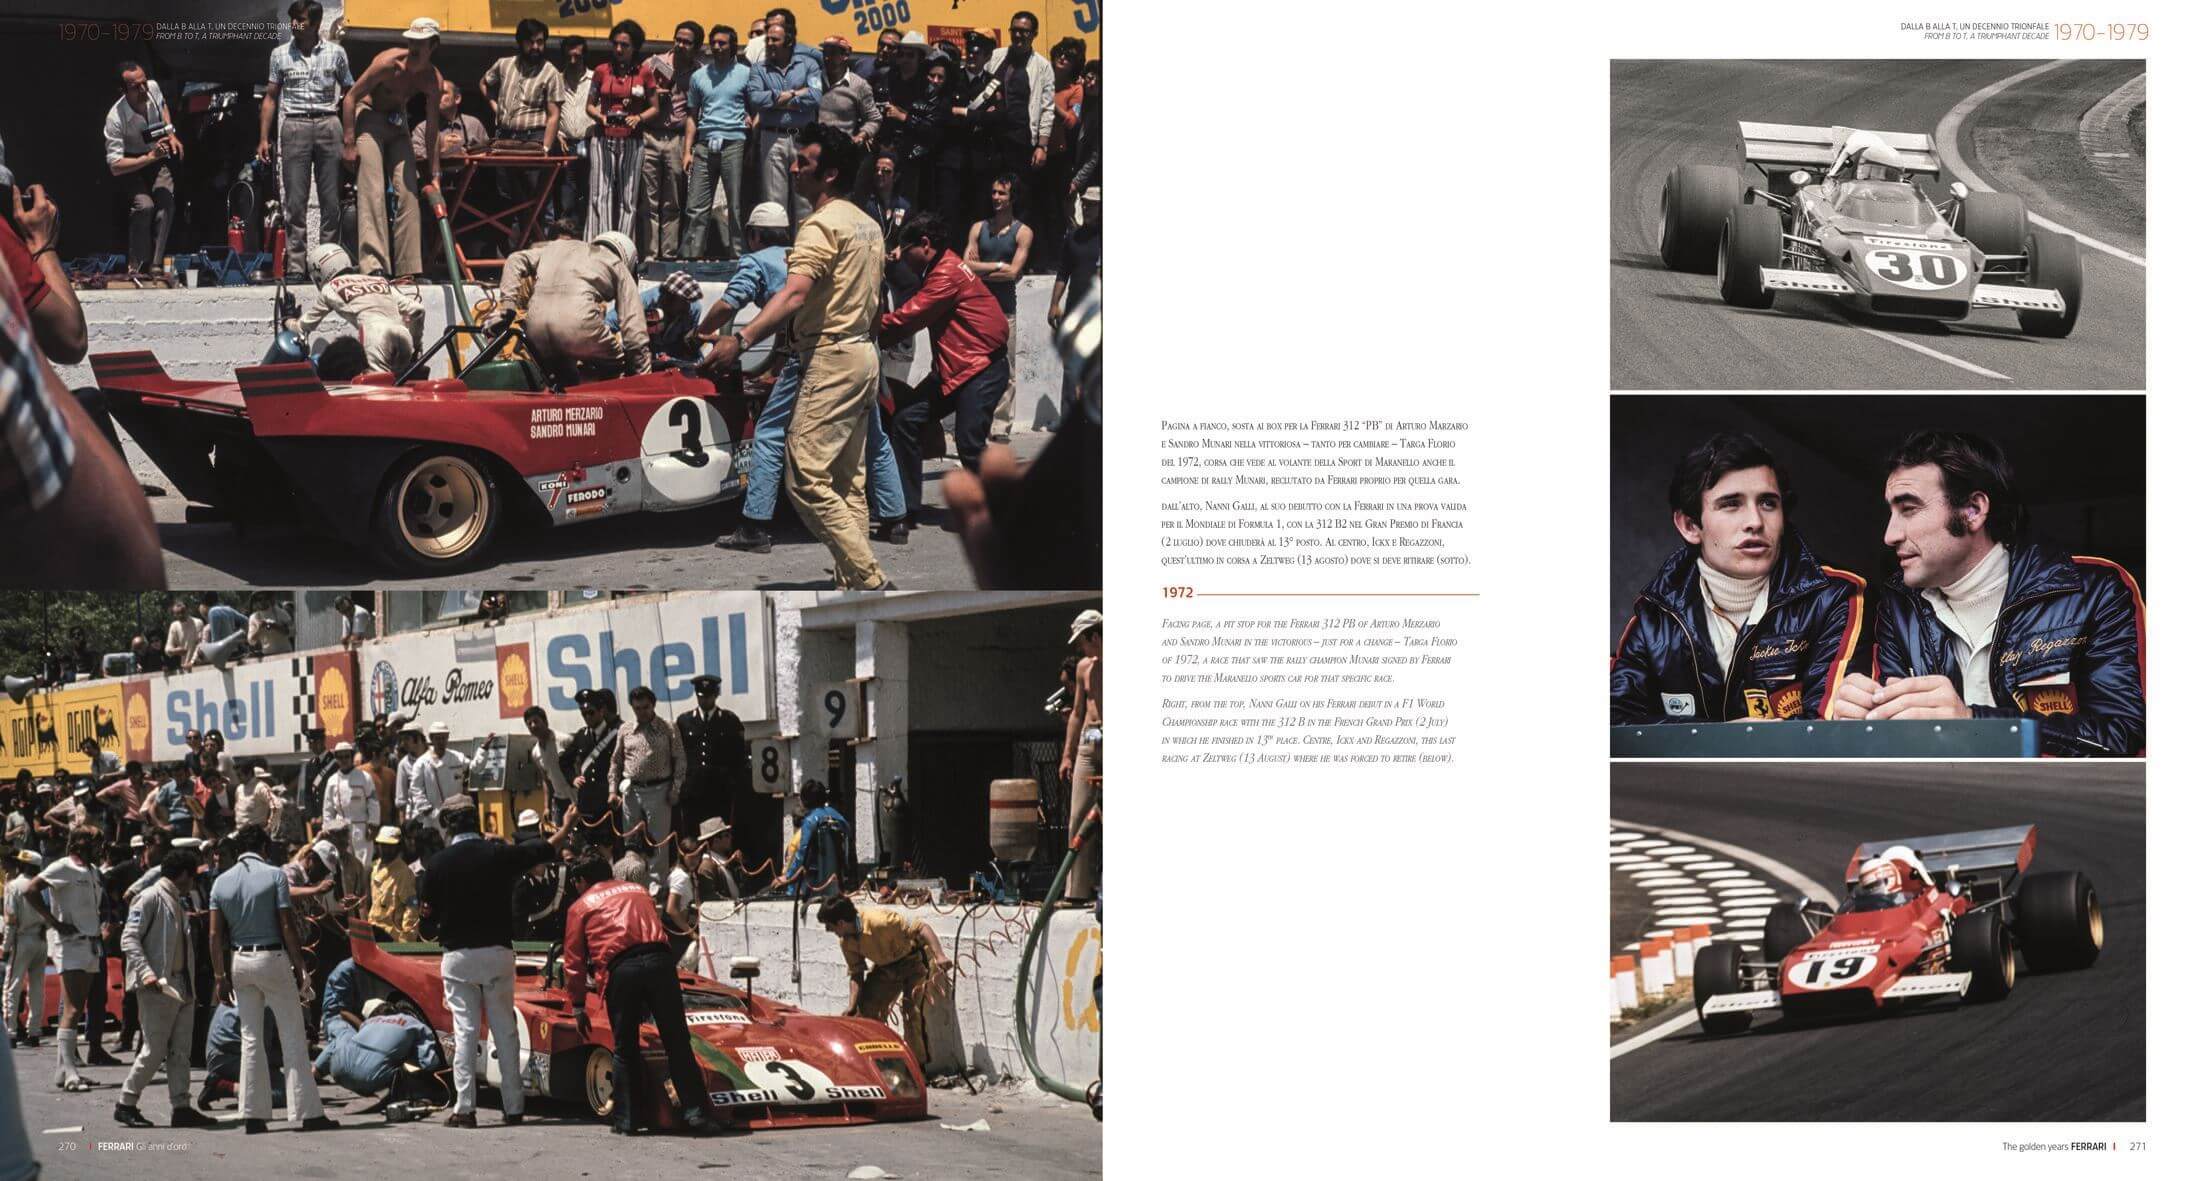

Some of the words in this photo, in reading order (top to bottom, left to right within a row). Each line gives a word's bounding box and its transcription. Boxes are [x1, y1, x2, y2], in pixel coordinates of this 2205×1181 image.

[854, 0, 912, 36] 2000
[1875, 251, 1958, 286] 30
[530, 423, 564, 439] SANDRO
[566, 422, 596, 437] MUNARI
[531, 408, 563, 422] ARTURO
[565, 406, 604, 421] MERZARIO
[669, 398, 711, 468] 3
[541, 481, 567, 490] KONI
[567, 489, 605, 503] FERODO
[504, 672, 524, 686] SHELL
[547, 612, 749, 711] Shell
[322, 692, 345, 711] SHELL
[401, 673, 437, 722] Alfa
[442, 667, 494, 705] Romeo
[824, 690, 846, 728] 9
[2040, 701, 2069, 712] SHELL
[129, 714, 147, 729] SHELL
[166, 679, 275, 746] Shell
[11, 716, 35, 758] AGIP
[761, 746, 779, 783] 8
[1805, 956, 1865, 984] 19
[711, 1090, 778, 1105] Shell
[765, 1061, 816, 1100] 3
[825, 1087, 885, 1099] Shell
